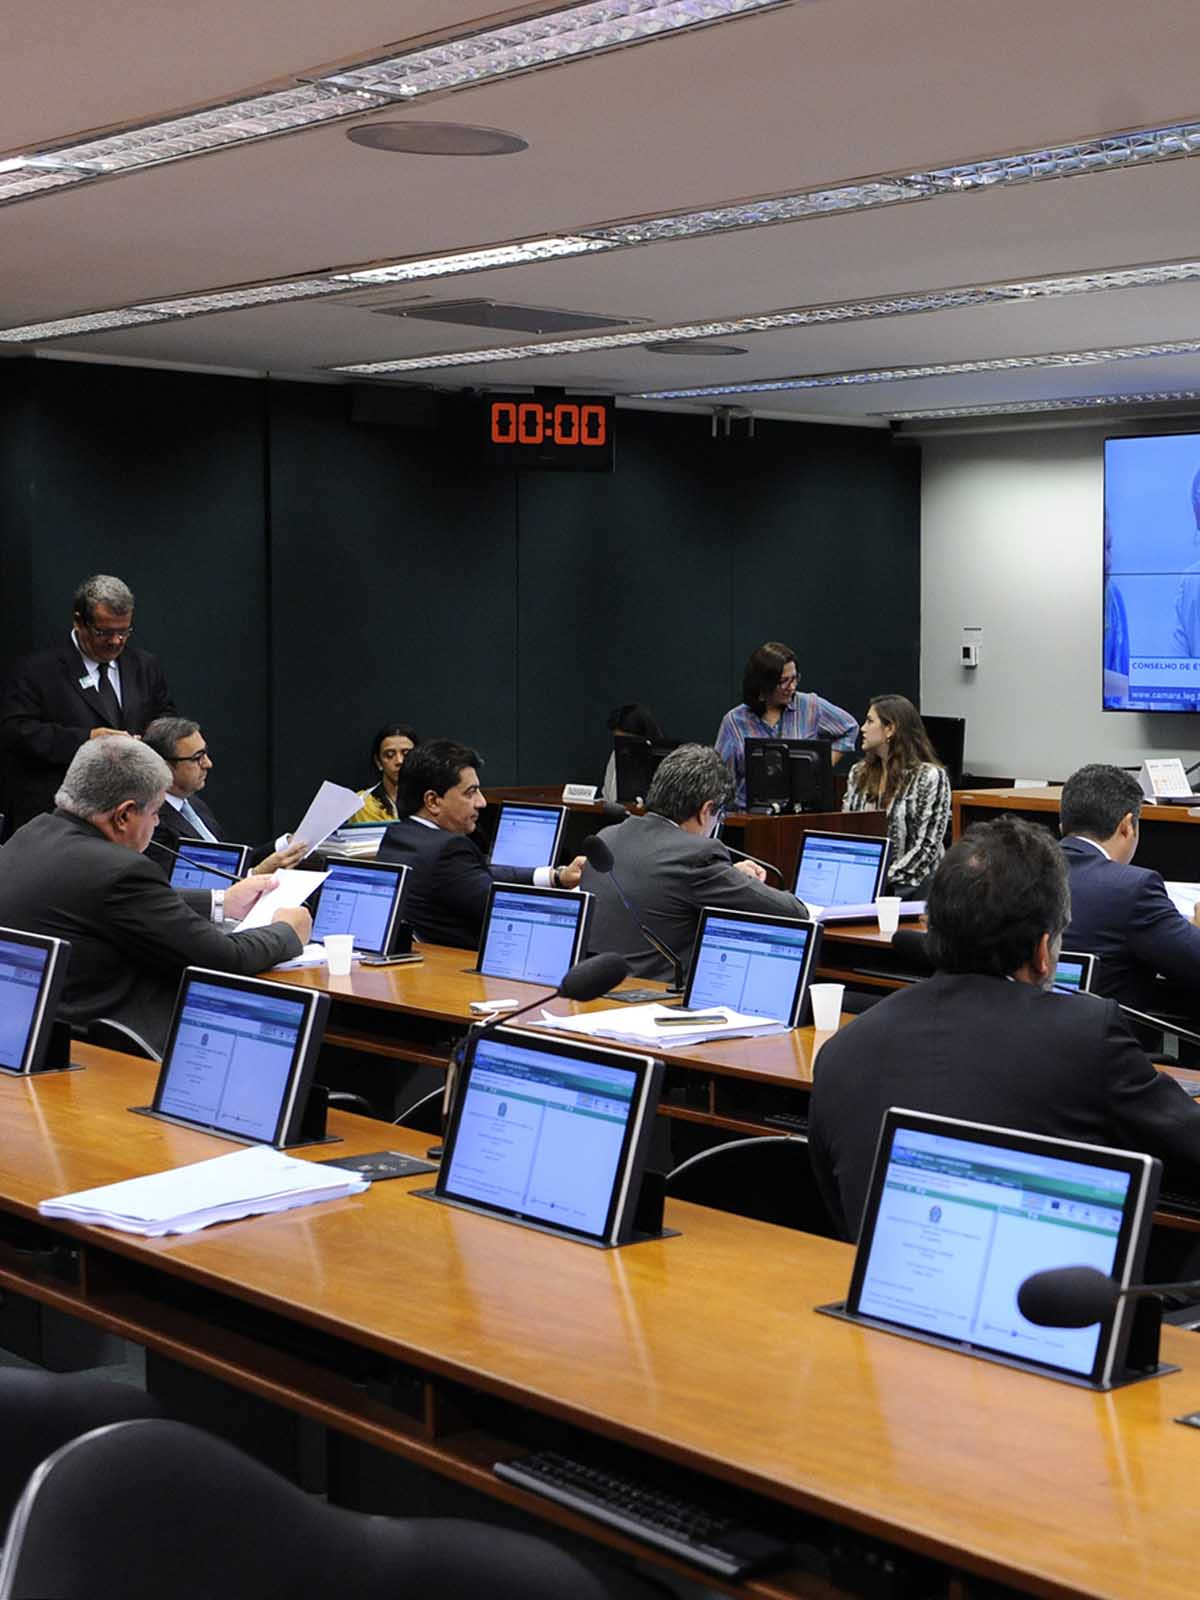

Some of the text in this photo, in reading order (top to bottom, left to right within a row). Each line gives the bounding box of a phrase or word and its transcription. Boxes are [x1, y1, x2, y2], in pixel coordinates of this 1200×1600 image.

[491, 402, 606, 446] 00:00
[1131, 662, 1178, 671] CONSELHO
[1180, 663, 1190, 671] DE
